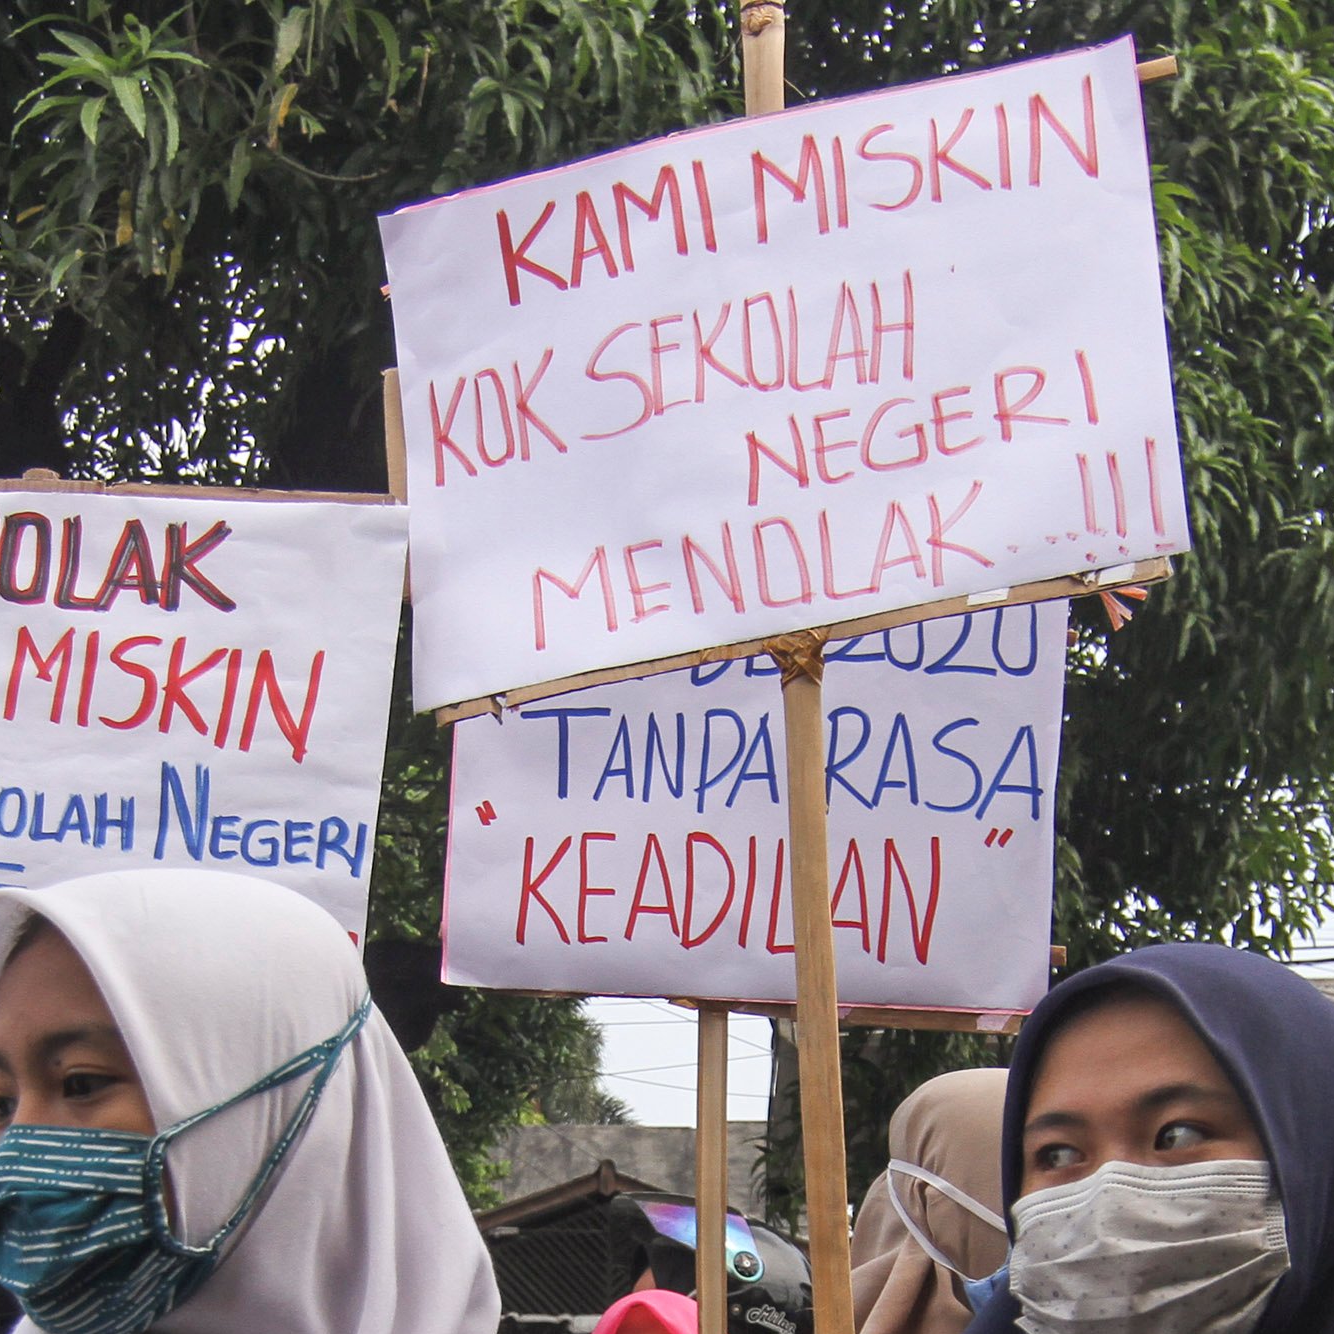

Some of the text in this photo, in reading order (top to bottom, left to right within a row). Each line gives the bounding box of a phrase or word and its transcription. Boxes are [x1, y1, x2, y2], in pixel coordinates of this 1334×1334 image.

[496, 74, 1099, 306] KAMI MISKIN
[429, 269, 915, 487] KOK SEKOLAH
[747, 349, 1099, 506] NEGERI
[4, 625, 326, 763] MISKIN
[521, 705, 1043, 821] TANPA RASA
[154, 761, 367, 878] NEGERI
